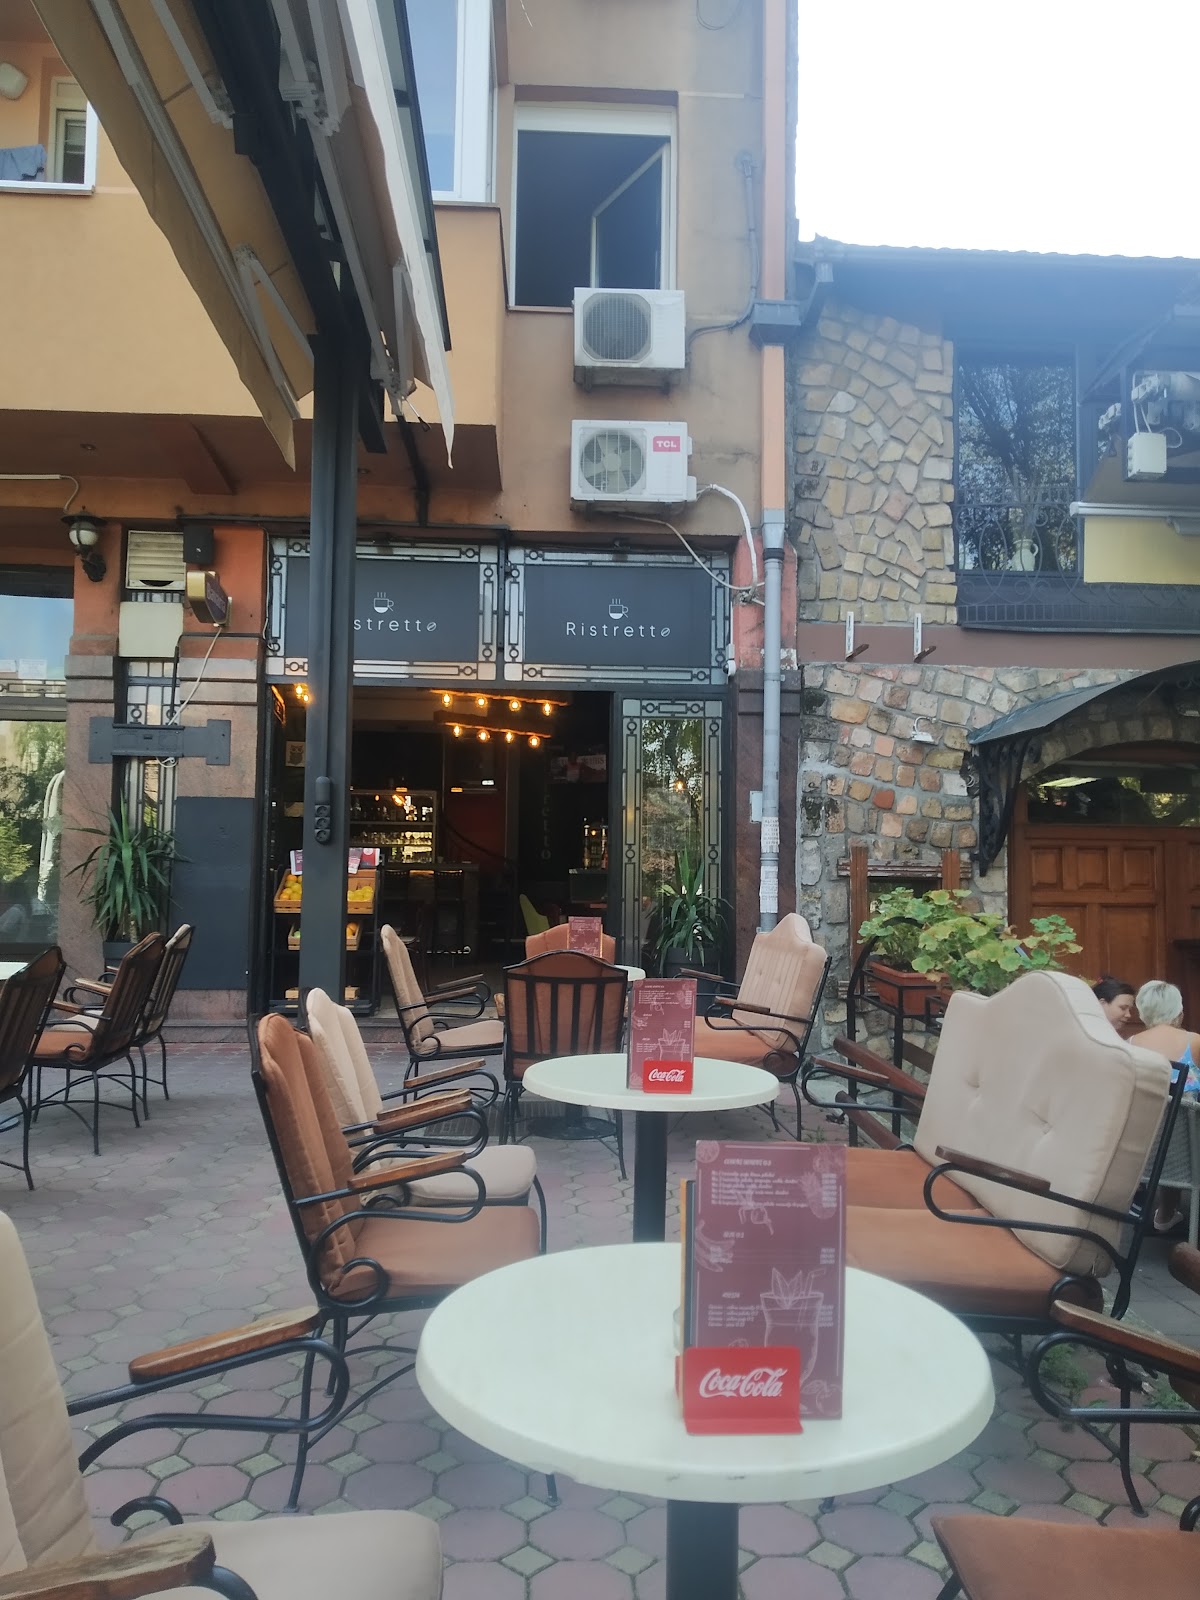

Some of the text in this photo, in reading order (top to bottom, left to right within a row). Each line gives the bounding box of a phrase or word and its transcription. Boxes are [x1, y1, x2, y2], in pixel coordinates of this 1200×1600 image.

[656, 440, 677, 448] TCL
[353, 618, 437, 632] stretto
[566, 621, 671, 638] Ristretto
[648, 1068, 686, 1082] Coca-Cola
[699, 1367, 788, 1398] Coca-Cola
